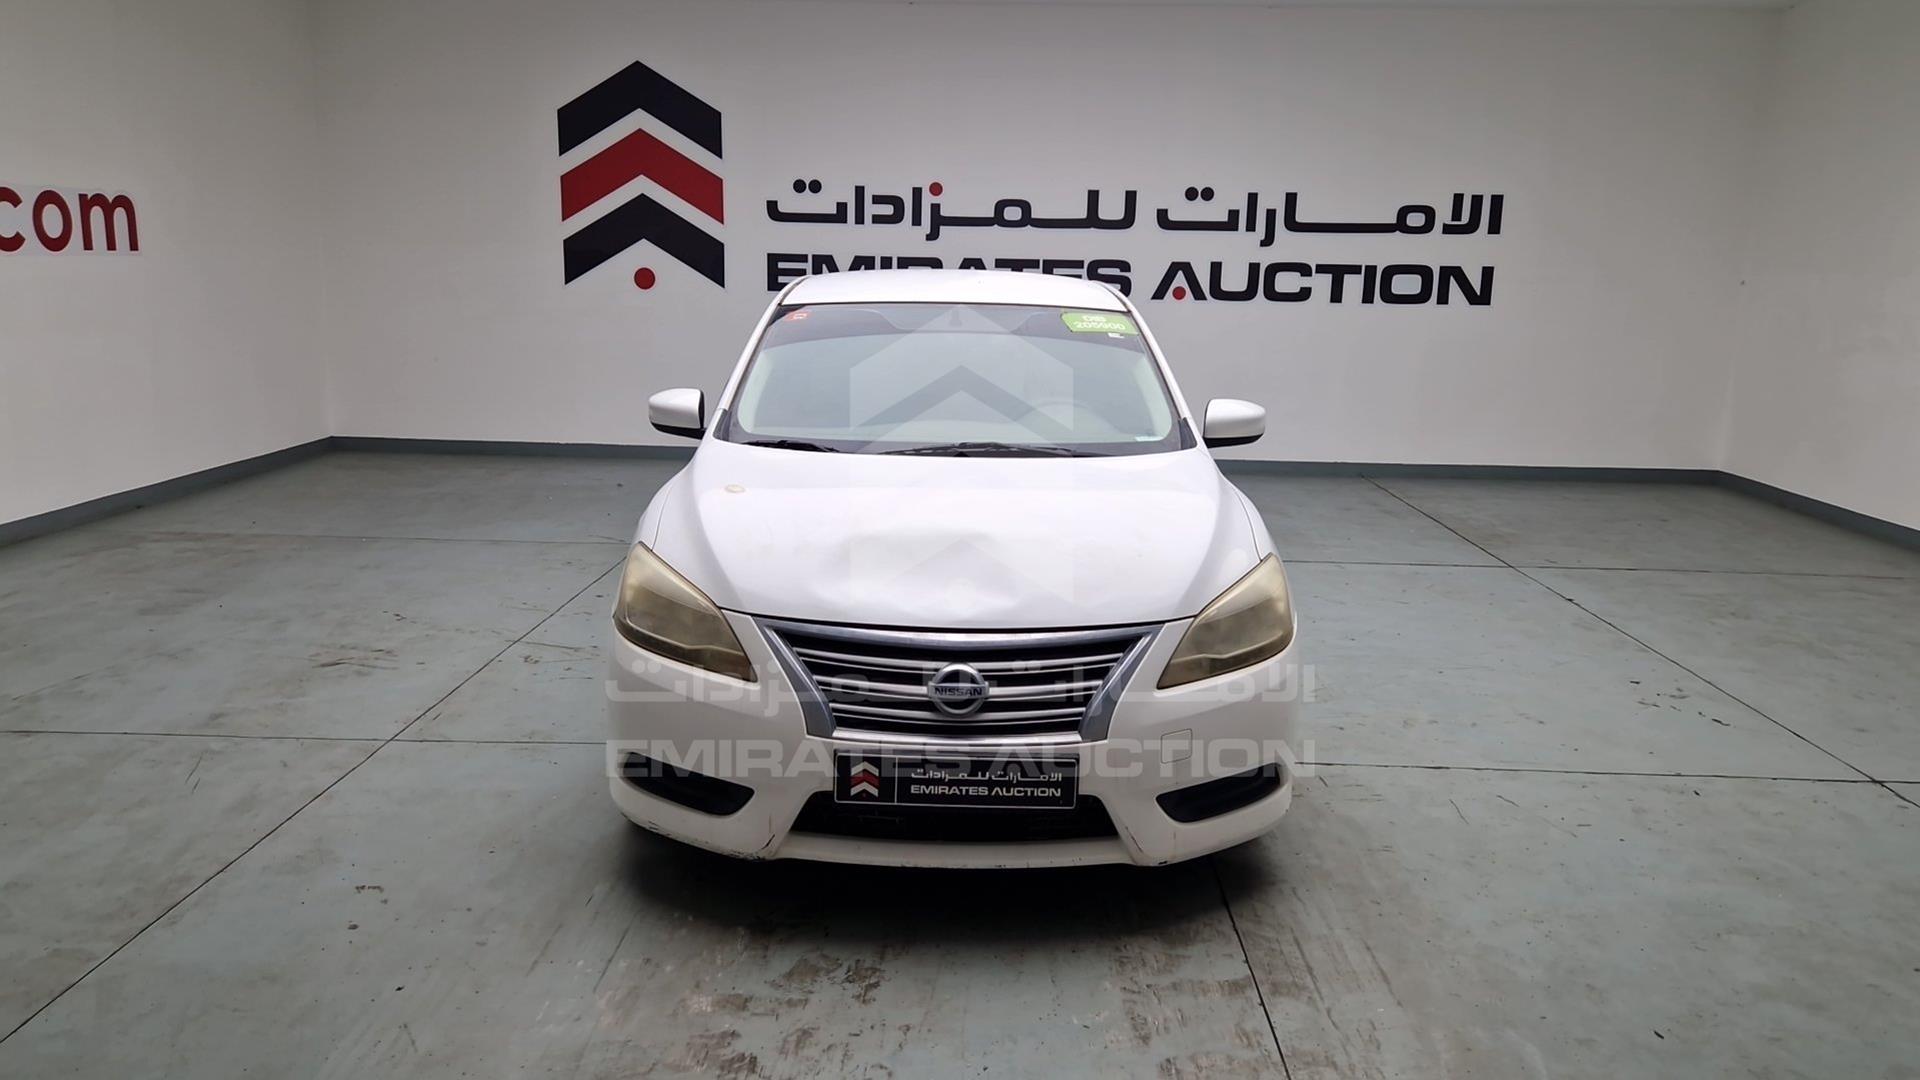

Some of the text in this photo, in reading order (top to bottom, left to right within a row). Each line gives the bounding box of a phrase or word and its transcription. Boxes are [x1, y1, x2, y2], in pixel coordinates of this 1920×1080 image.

[0, 186, 139, 252] com
[766, 178, 1138, 242] للمزادات
[1150, 260, 1495, 306] AUCTION
[934, 686, 983, 697] NISSAN
[910, 784, 1061, 797] EMIRATES AUCTION
